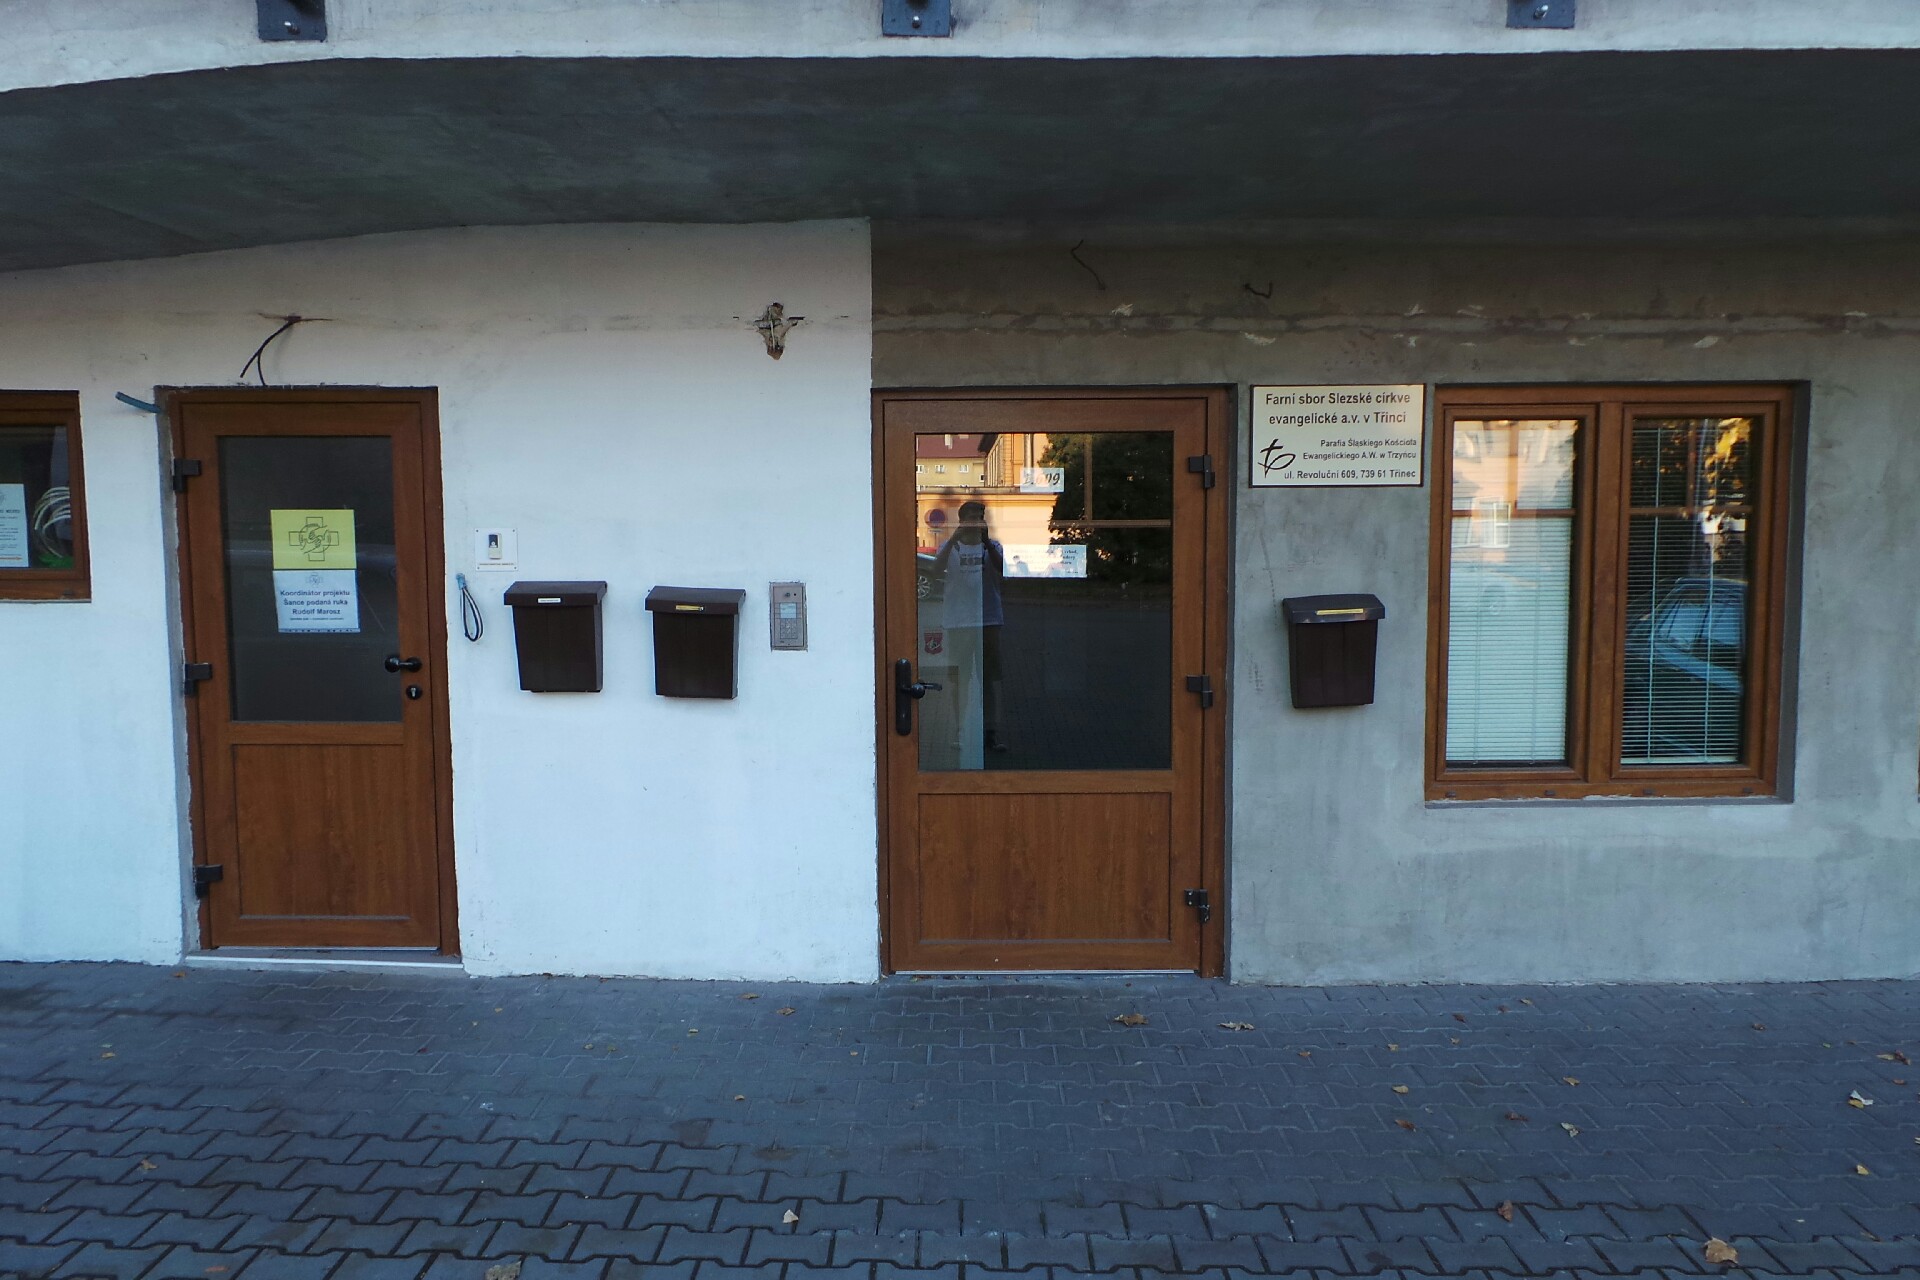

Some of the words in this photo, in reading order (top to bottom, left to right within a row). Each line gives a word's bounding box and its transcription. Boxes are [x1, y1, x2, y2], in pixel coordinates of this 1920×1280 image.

[1266, 392, 1296, 404] Farní
[1298, 393, 1325, 404] sbor
[1328, 392, 1372, 404] Slezské
[1376, 392, 1410, 404] církve
[1269, 412, 1338, 426] evangelické
[1341, 415, 1360, 424] a.v.
[1364, 415, 1370, 424] v
[1374, 412, 1406, 424] Třinci
[1348, 438, 1383, 448] Śląskiego
[1303, 452, 1360, 462] Ewangelickiego
[1388, 452, 1417, 460] Trzyńcu
[1284, 472, 1294, 480] ul.
[1297, 469, 1340, 479] Revoluční
[1341, 470, 1358, 480] 609,
[1360, 470, 1375, 478] 739
[1377, 470, 1386, 478] 61
[1390, 468, 1416, 478] Třinec
